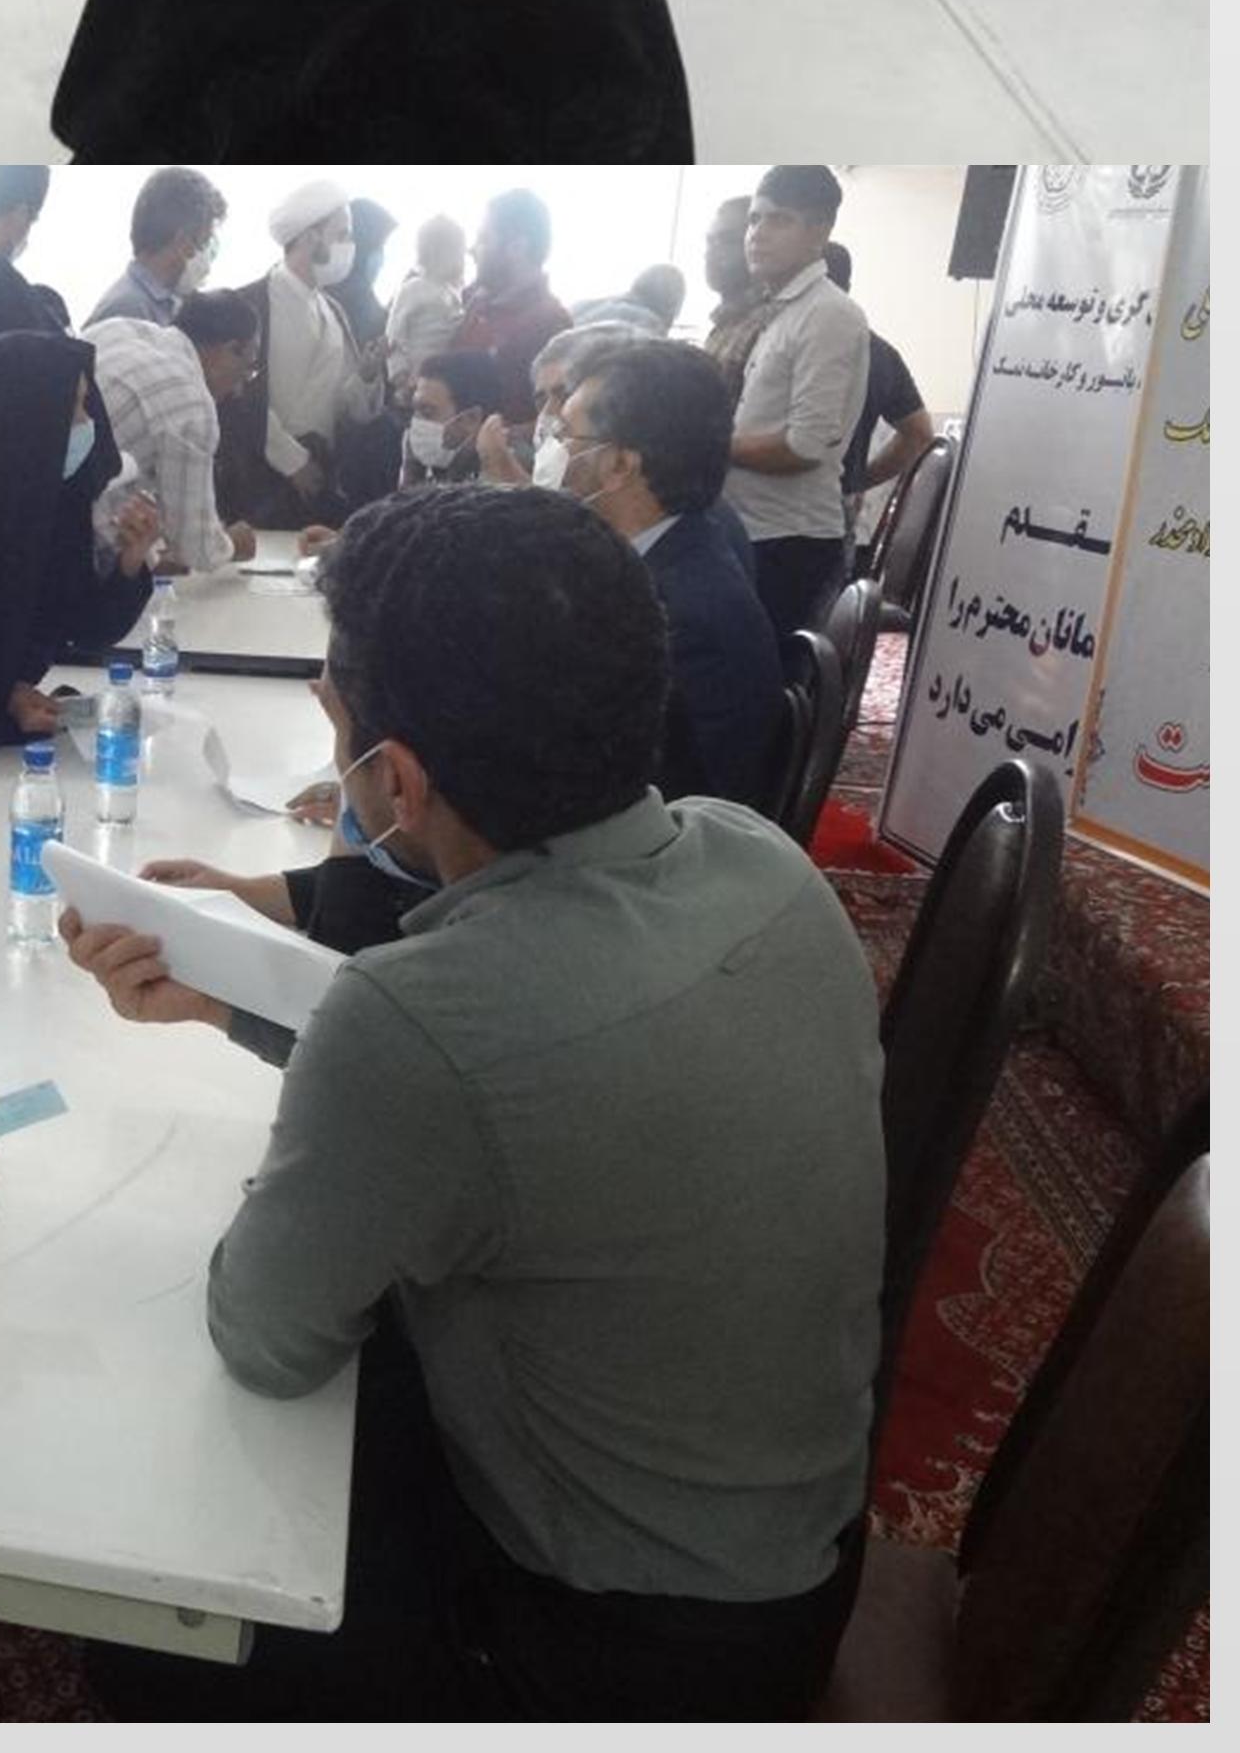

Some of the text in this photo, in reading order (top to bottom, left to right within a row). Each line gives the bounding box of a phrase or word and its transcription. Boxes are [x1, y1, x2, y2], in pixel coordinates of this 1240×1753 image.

[1000, 504, 1112, 556] قدم
[947, 576, 965, 630] را
[961, 593, 1031, 639] محترم
